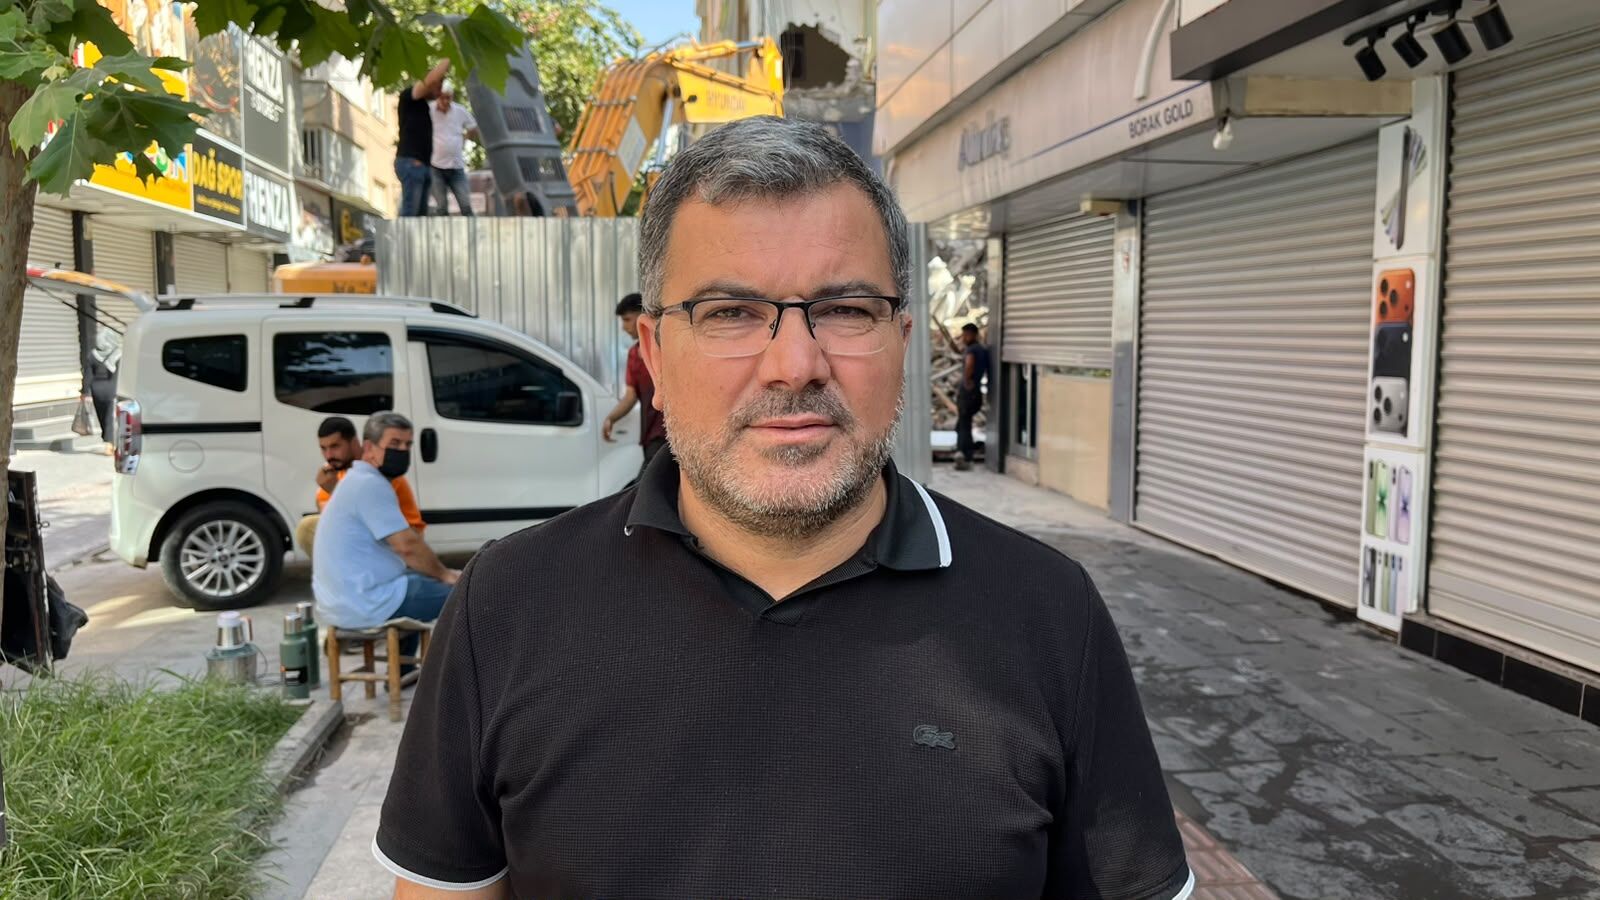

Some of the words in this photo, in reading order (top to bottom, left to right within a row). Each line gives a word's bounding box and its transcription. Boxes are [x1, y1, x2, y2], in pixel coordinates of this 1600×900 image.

[1129, 112, 1162, 138] BORAK
[1163, 99, 1193, 125] GOLD
[193, 148, 216, 191] DAĞ
[217, 161, 243, 200] SPOR
